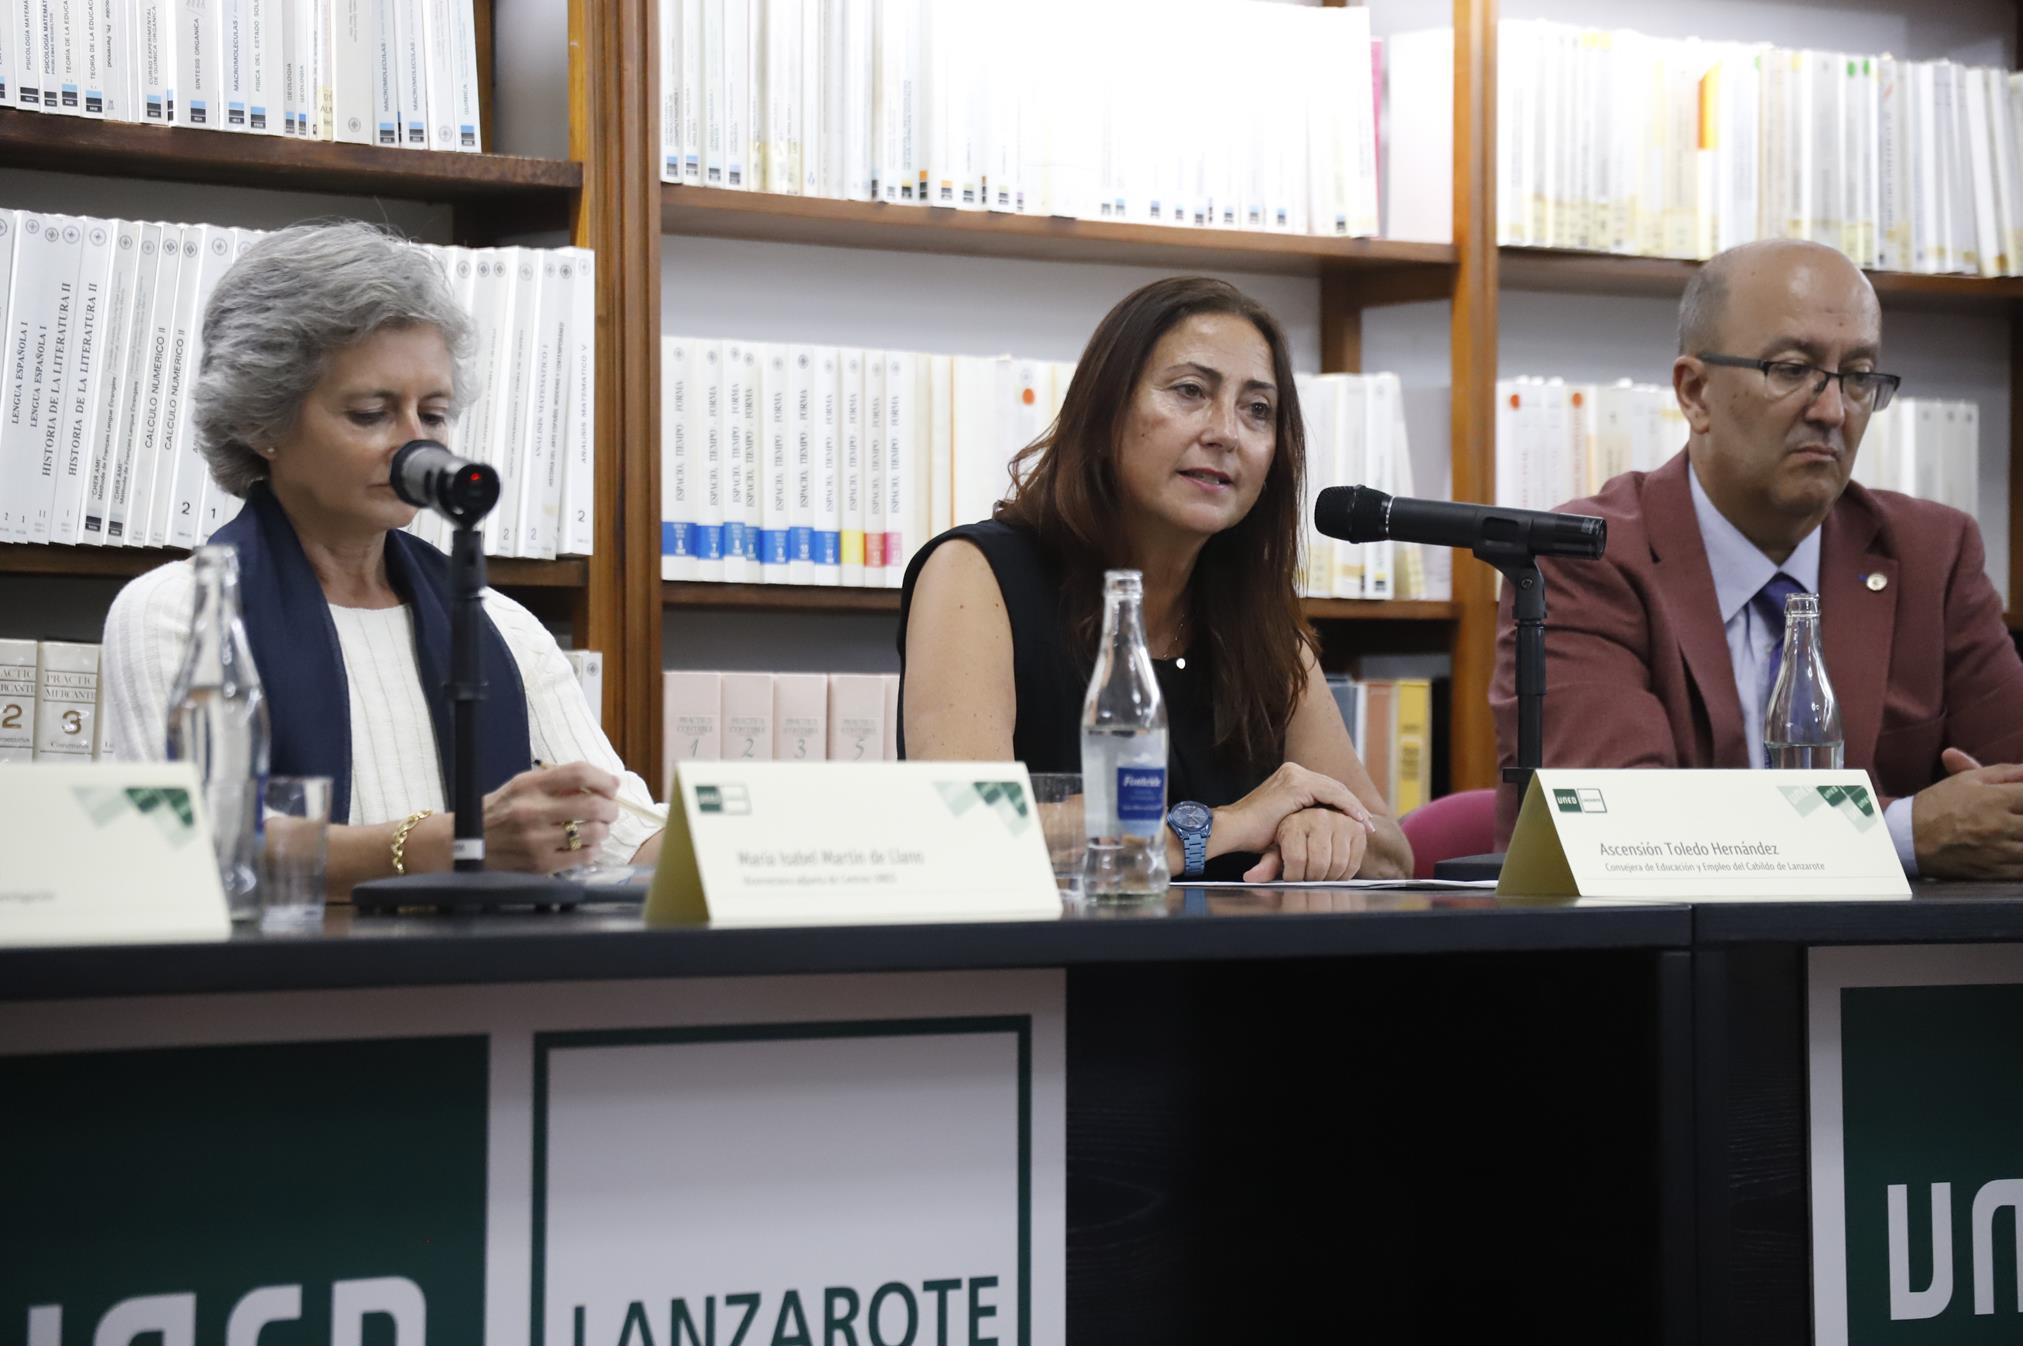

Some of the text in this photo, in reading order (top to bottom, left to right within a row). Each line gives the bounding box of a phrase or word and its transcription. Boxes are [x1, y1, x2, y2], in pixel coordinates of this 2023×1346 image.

[15, 330, 28, 380] ESPAÑOLA
[34, 334, 46, 384] ESPAÑOLA
[42, 282, 71, 477] HISTORIA DE LA LITERATURA II
[68, 282, 97, 477] HISTORIA DE LA LITERATURA II
[11, 385, 22, 425] LENGUA
[145, 398, 158, 449] CALCULO
[152, 336, 165, 394] NUMERICO
[164, 400, 177, 450] CALCULO
[171, 338, 184, 396] NUMERICO
[30, 388, 41, 429] LENGUA
[182, 501, 190, 515] 2
[211, 508, 216, 519] 1
[578, 510, 585, 523] 2
[504, 528, 510, 540] 2
[2, 704, 22, 729] 2
[62, 710, 82, 736] 3
[690, 738, 699, 758] 1
[742, 738, 754, 758] 2
[794, 738, 806, 759] 3
[1600, 842, 1780, 856] Ascensión Toledo Hernández
[1604, 862, 1644, 873] Consejera
[1645, 862, 1654, 872] de
[1656, 862, 1694, 872] Educación
[1702, 862, 1731, 872] Empleo
[1732, 861, 1744, 871] del
[1746, 861, 1775, 871] Cabildo
[1776, 861, 1786, 870] de
[1788, 862, 1825, 870] Lanzarote
